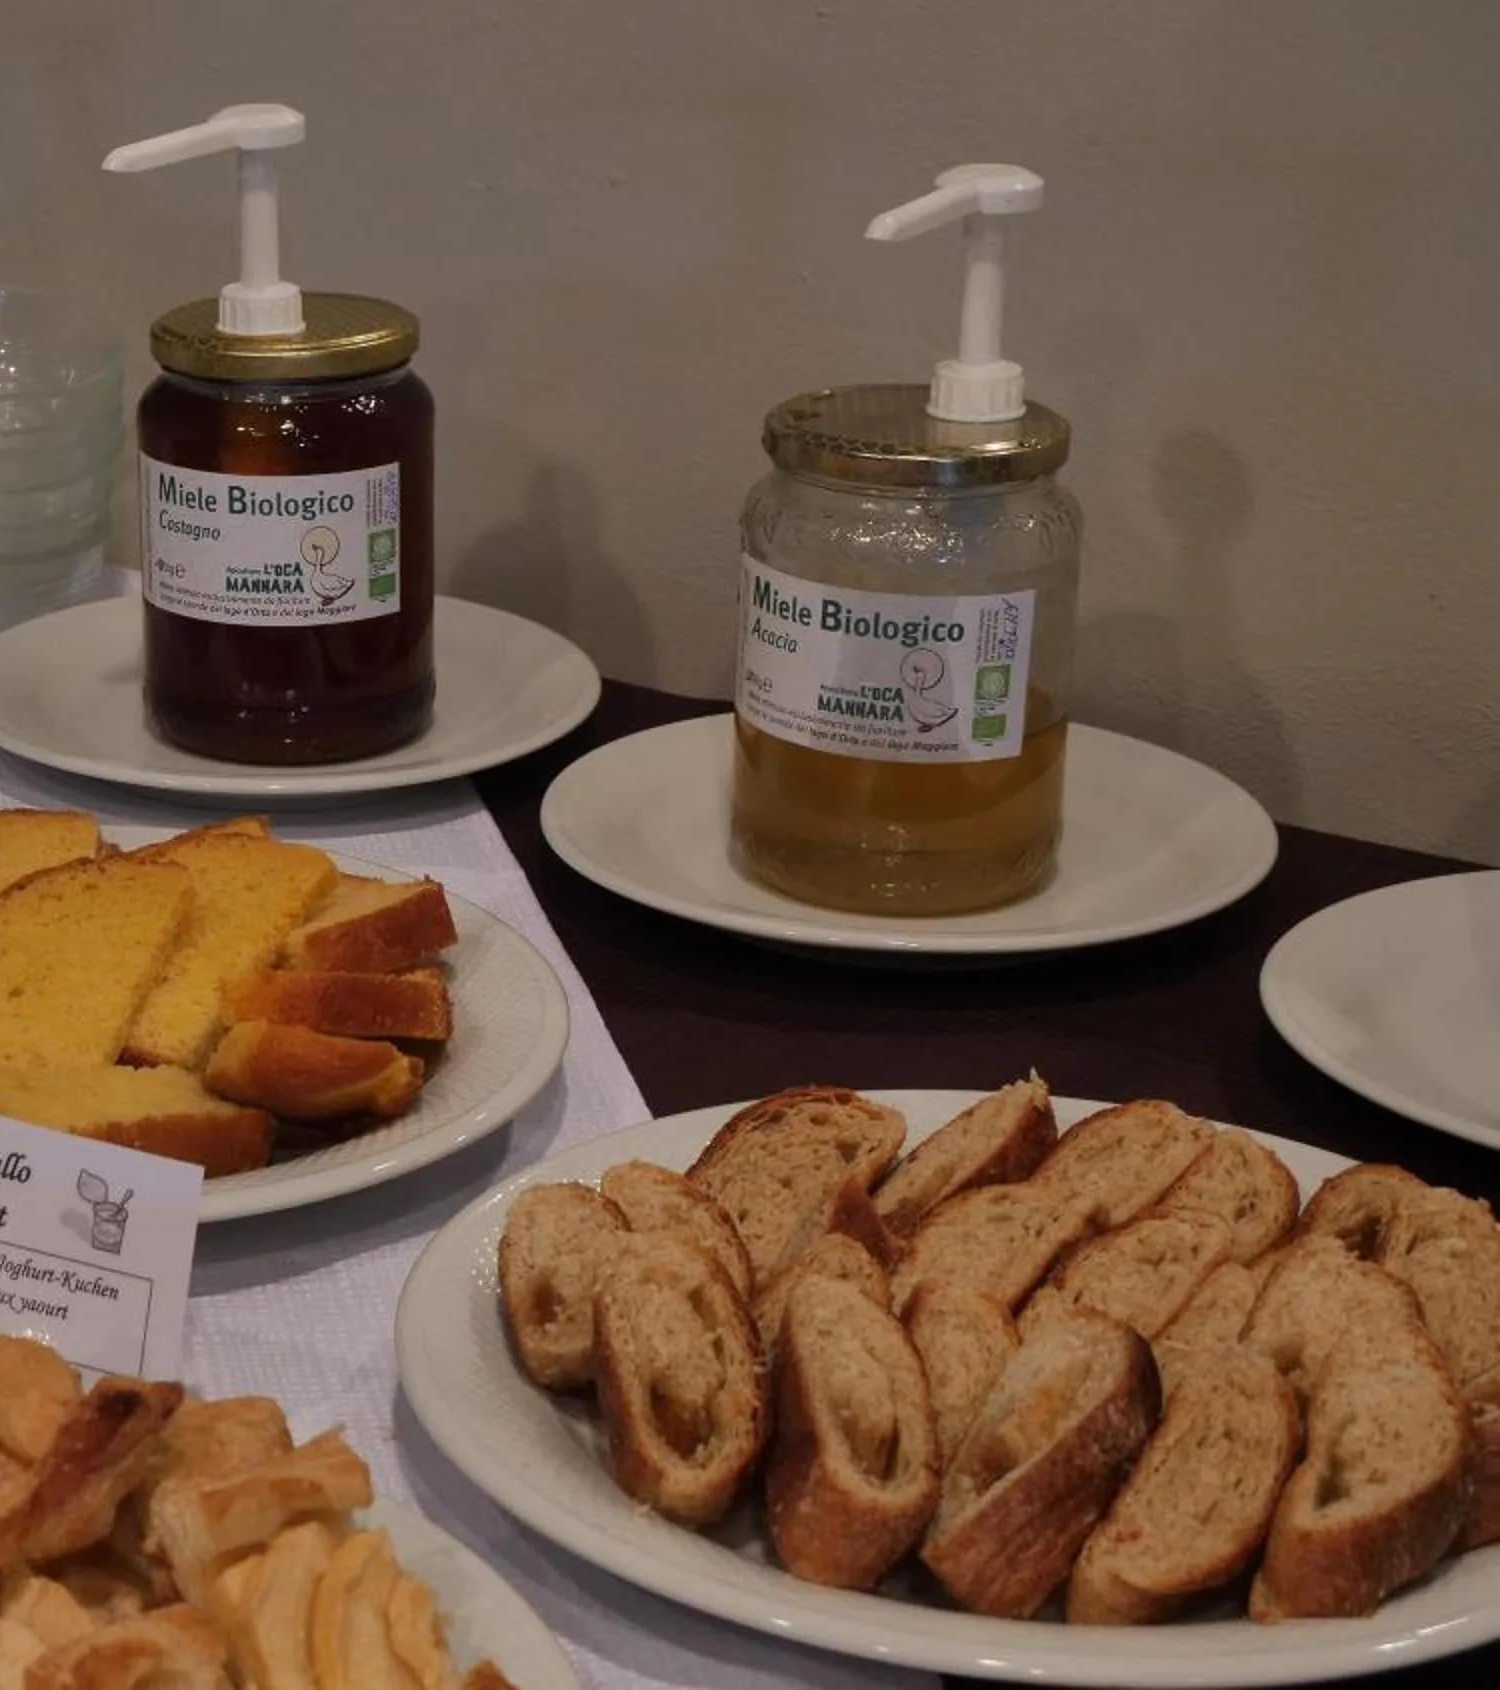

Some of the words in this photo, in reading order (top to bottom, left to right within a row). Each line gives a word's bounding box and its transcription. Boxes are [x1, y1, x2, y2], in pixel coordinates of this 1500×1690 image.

[158, 472, 218, 513] Miele
[227, 485, 355, 521] Biologico
[263, 561, 304, 577] L'OCA
[225, 576, 305, 594] MANNARA
[753, 575, 813, 627] Miele
[820, 599, 965, 648] Biologico
[751, 616, 798, 653] Acacia
[817, 693, 904, 723] MANNARA
[859, 685, 904, 704] L'OCA
[15, 1295, 70, 1320] yaourt
